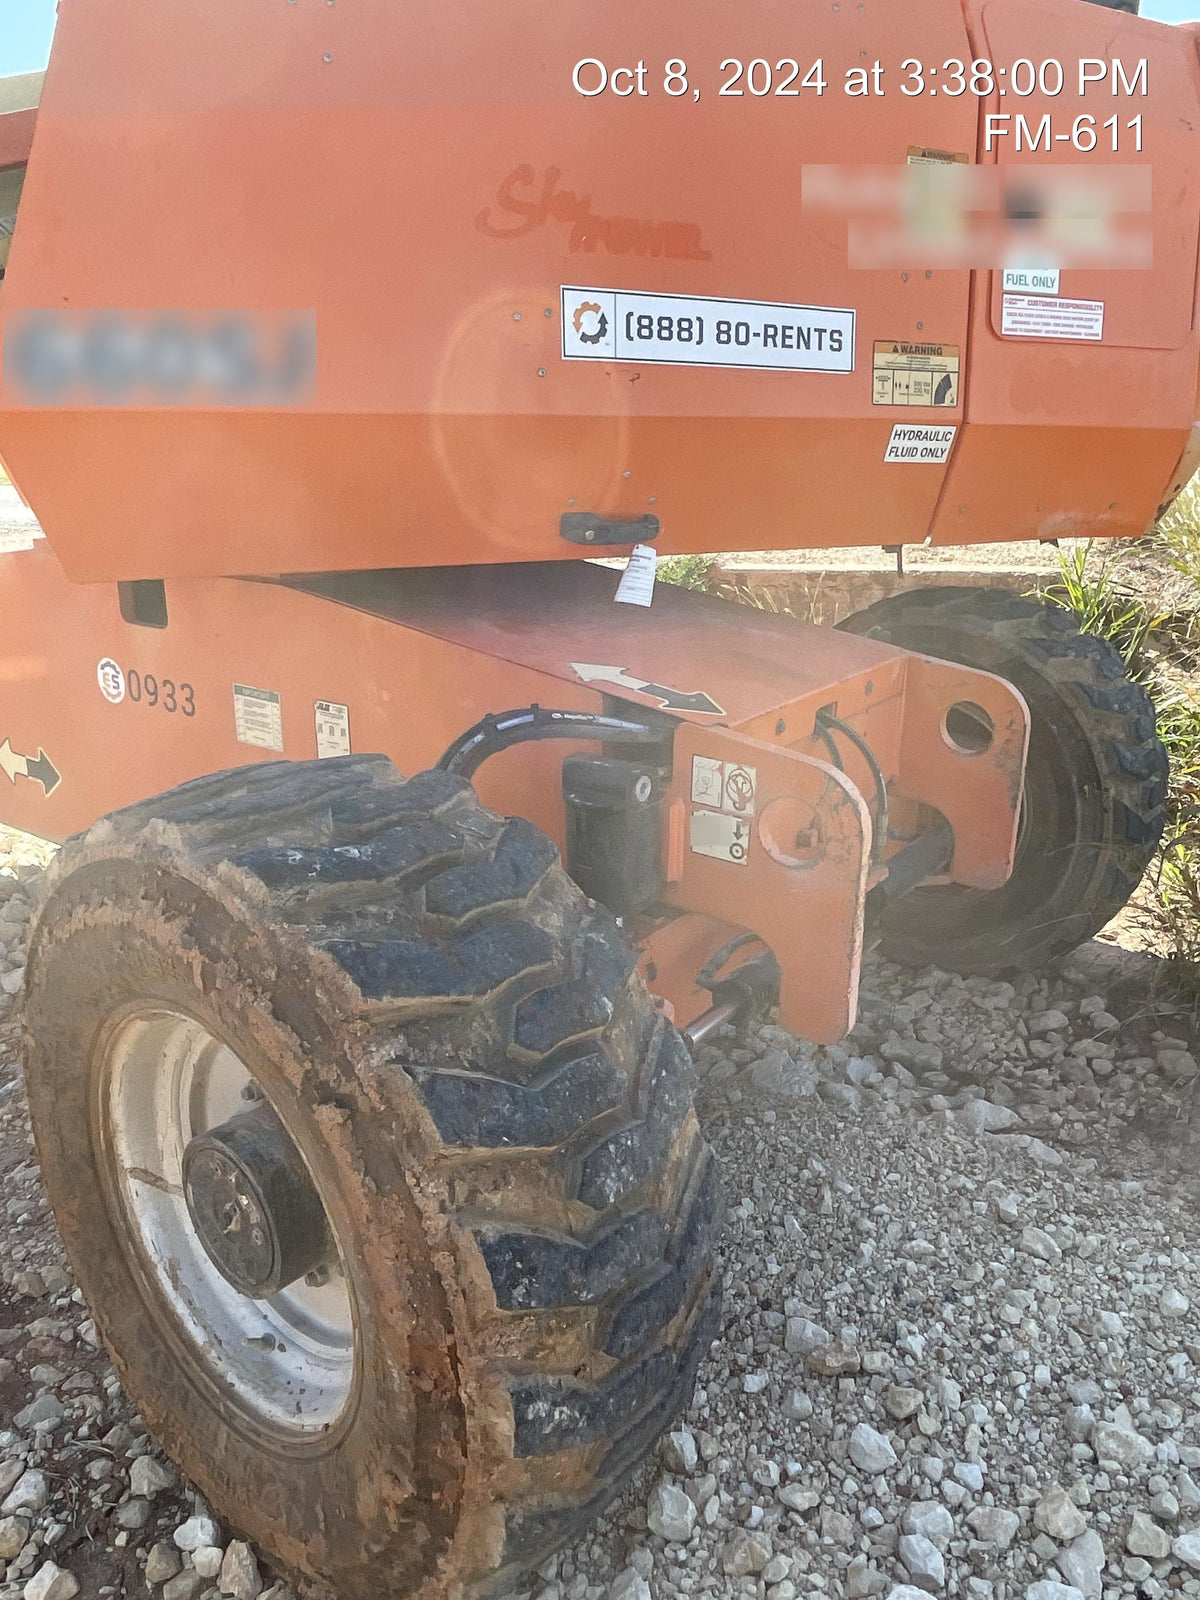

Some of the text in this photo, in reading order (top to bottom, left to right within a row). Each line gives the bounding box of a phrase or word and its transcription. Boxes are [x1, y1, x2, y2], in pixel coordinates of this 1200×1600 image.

[1006, 273, 1056, 288] FUEL ONLY
[625, 311, 843, 352] (888) 80-RENTS
[900, 345, 943, 356] WARNING
[893, 429, 952, 442] HYDRAULIC
[888, 446, 947, 458] FLUID ONLY
[127, 669, 196, 717] 0933
